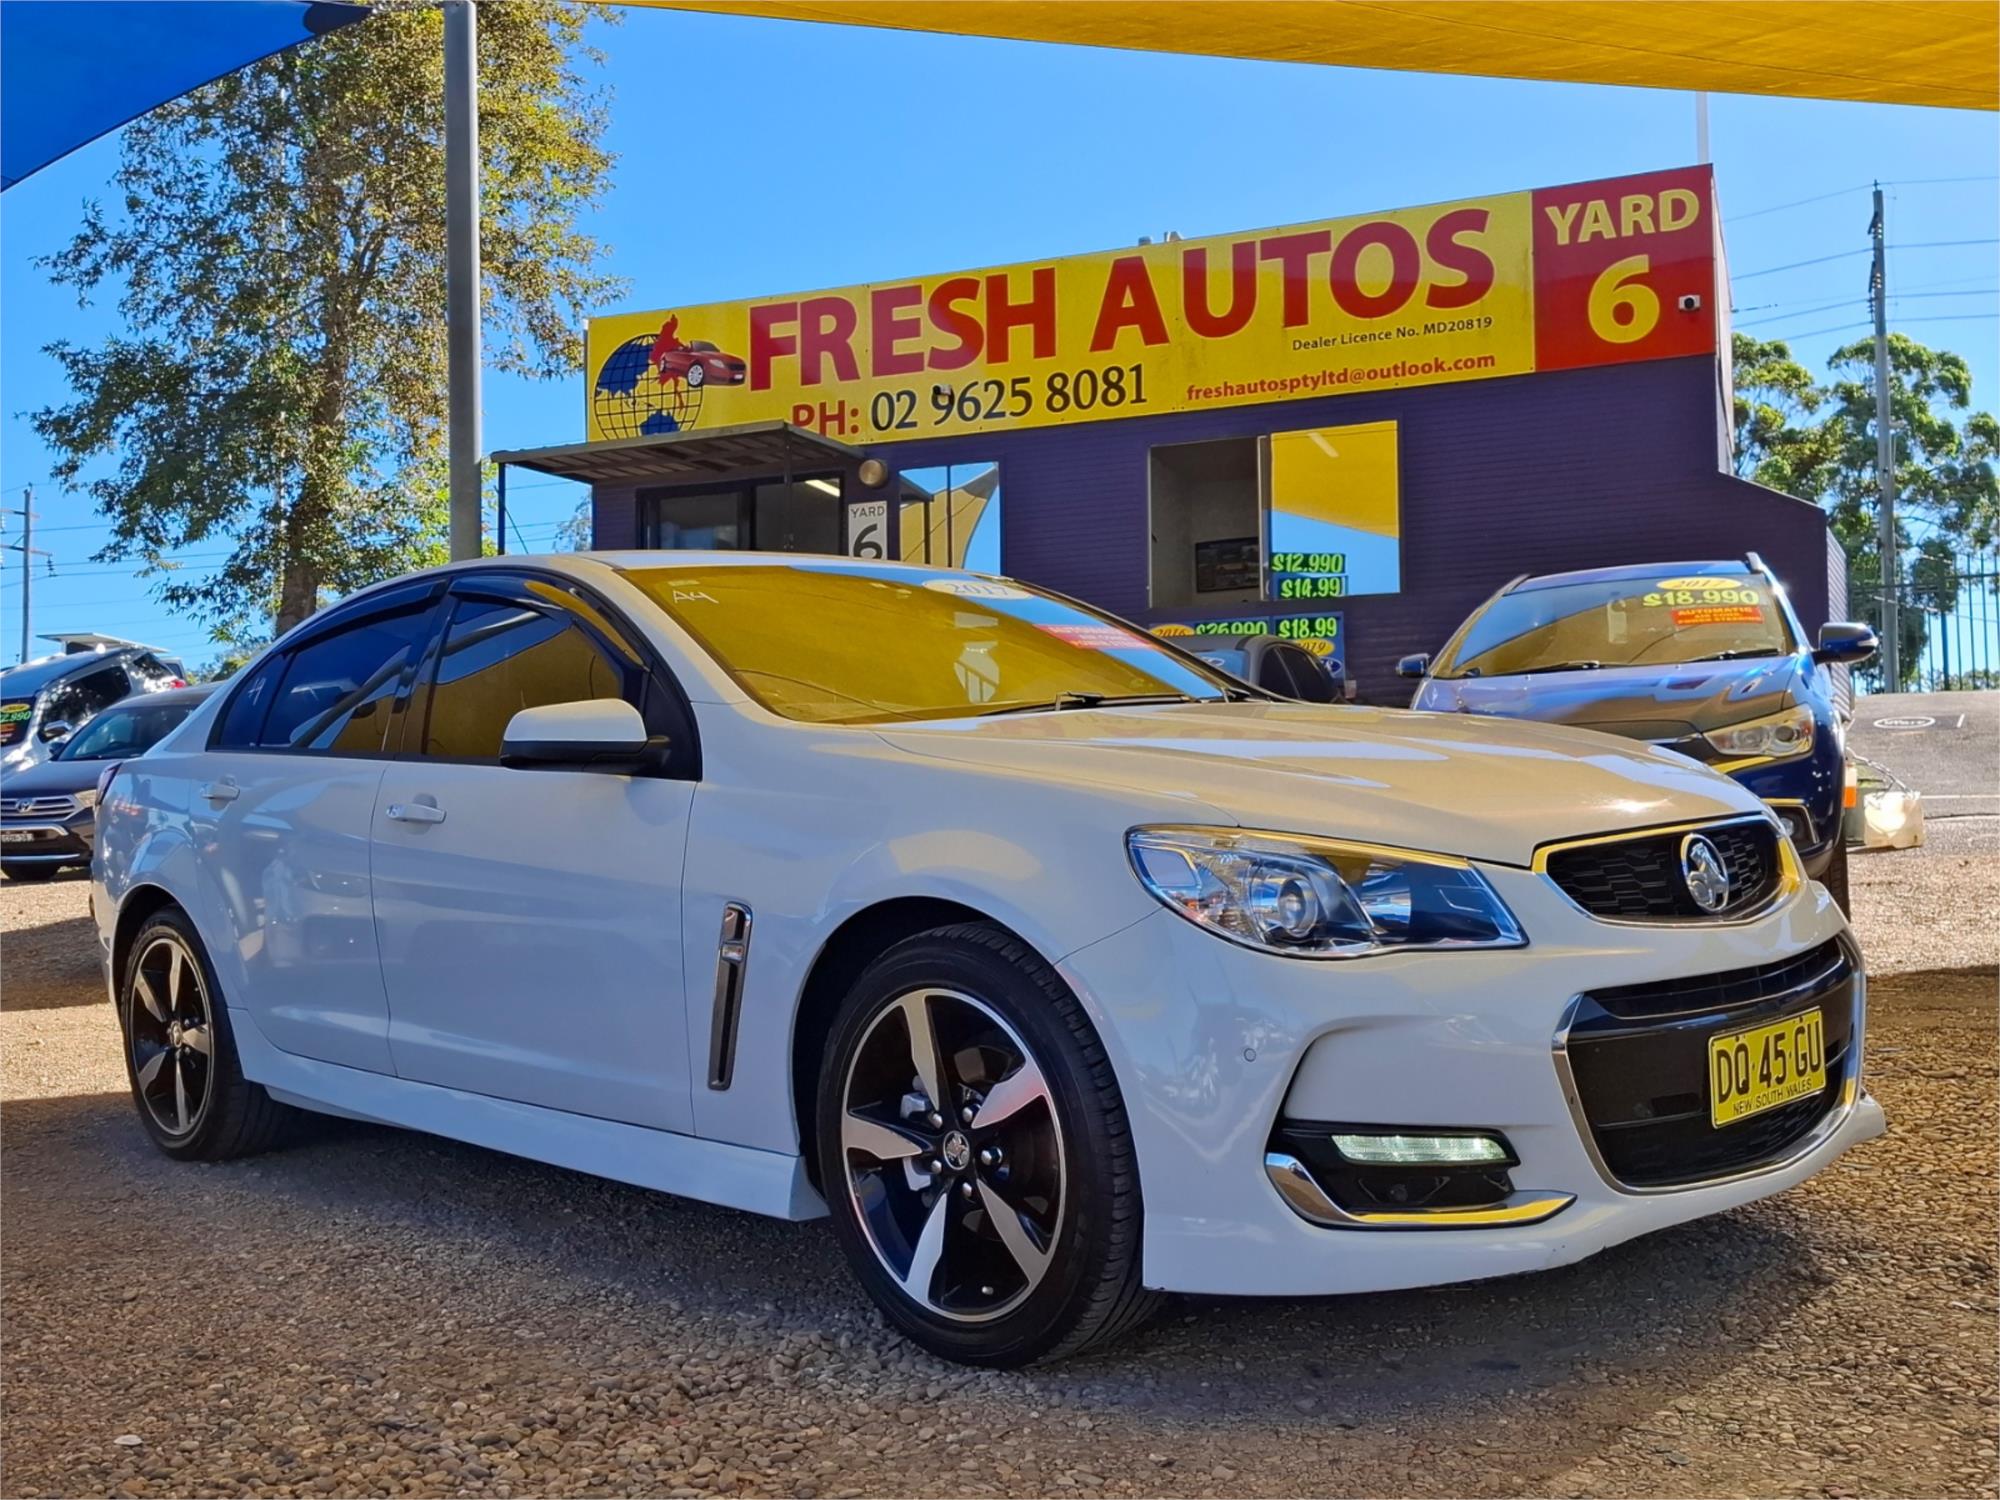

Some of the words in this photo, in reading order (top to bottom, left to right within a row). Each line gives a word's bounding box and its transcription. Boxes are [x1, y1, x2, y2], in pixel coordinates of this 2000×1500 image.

[1545, 187, 1700, 246] YARD
[749, 267, 1057, 392] FRESH
[1088, 208, 1496, 353] AUTOS
[1587, 255, 1661, 345] 6
[1292, 336, 1337, 351] Dealer
[1340, 330, 1393, 346] Licence
[1396, 326, 1420, 340] No.
[1423, 316, 1493, 336] MD20819
[1187, 353, 1496, 401] freshautosptyltd@outlook.com
[791, 399, 860, 438] PH:
[871, 389, 918, 432] 02
[931, 377, 1032, 427] 9625
[1046, 363, 1148, 413] 8081
[850, 505, 885, 518] YARD
[853, 523, 883, 559] 6
[1271, 553, 1344, 573] $12.990
[945, 583, 1009, 596] 2017
[1642, 589, 1760, 607] $18.990
[1278, 617, 1337, 638] $18.99
[1716, 1043, 1750, 1104] DQ
[1759, 1032, 1787, 1088] 45
[1794, 1021, 1821, 1078] GU
[1733, 1098, 1753, 1114] NEW
[1755, 1090, 1783, 1107] SOUTH
[1787, 1078, 1812, 1096] WALES
